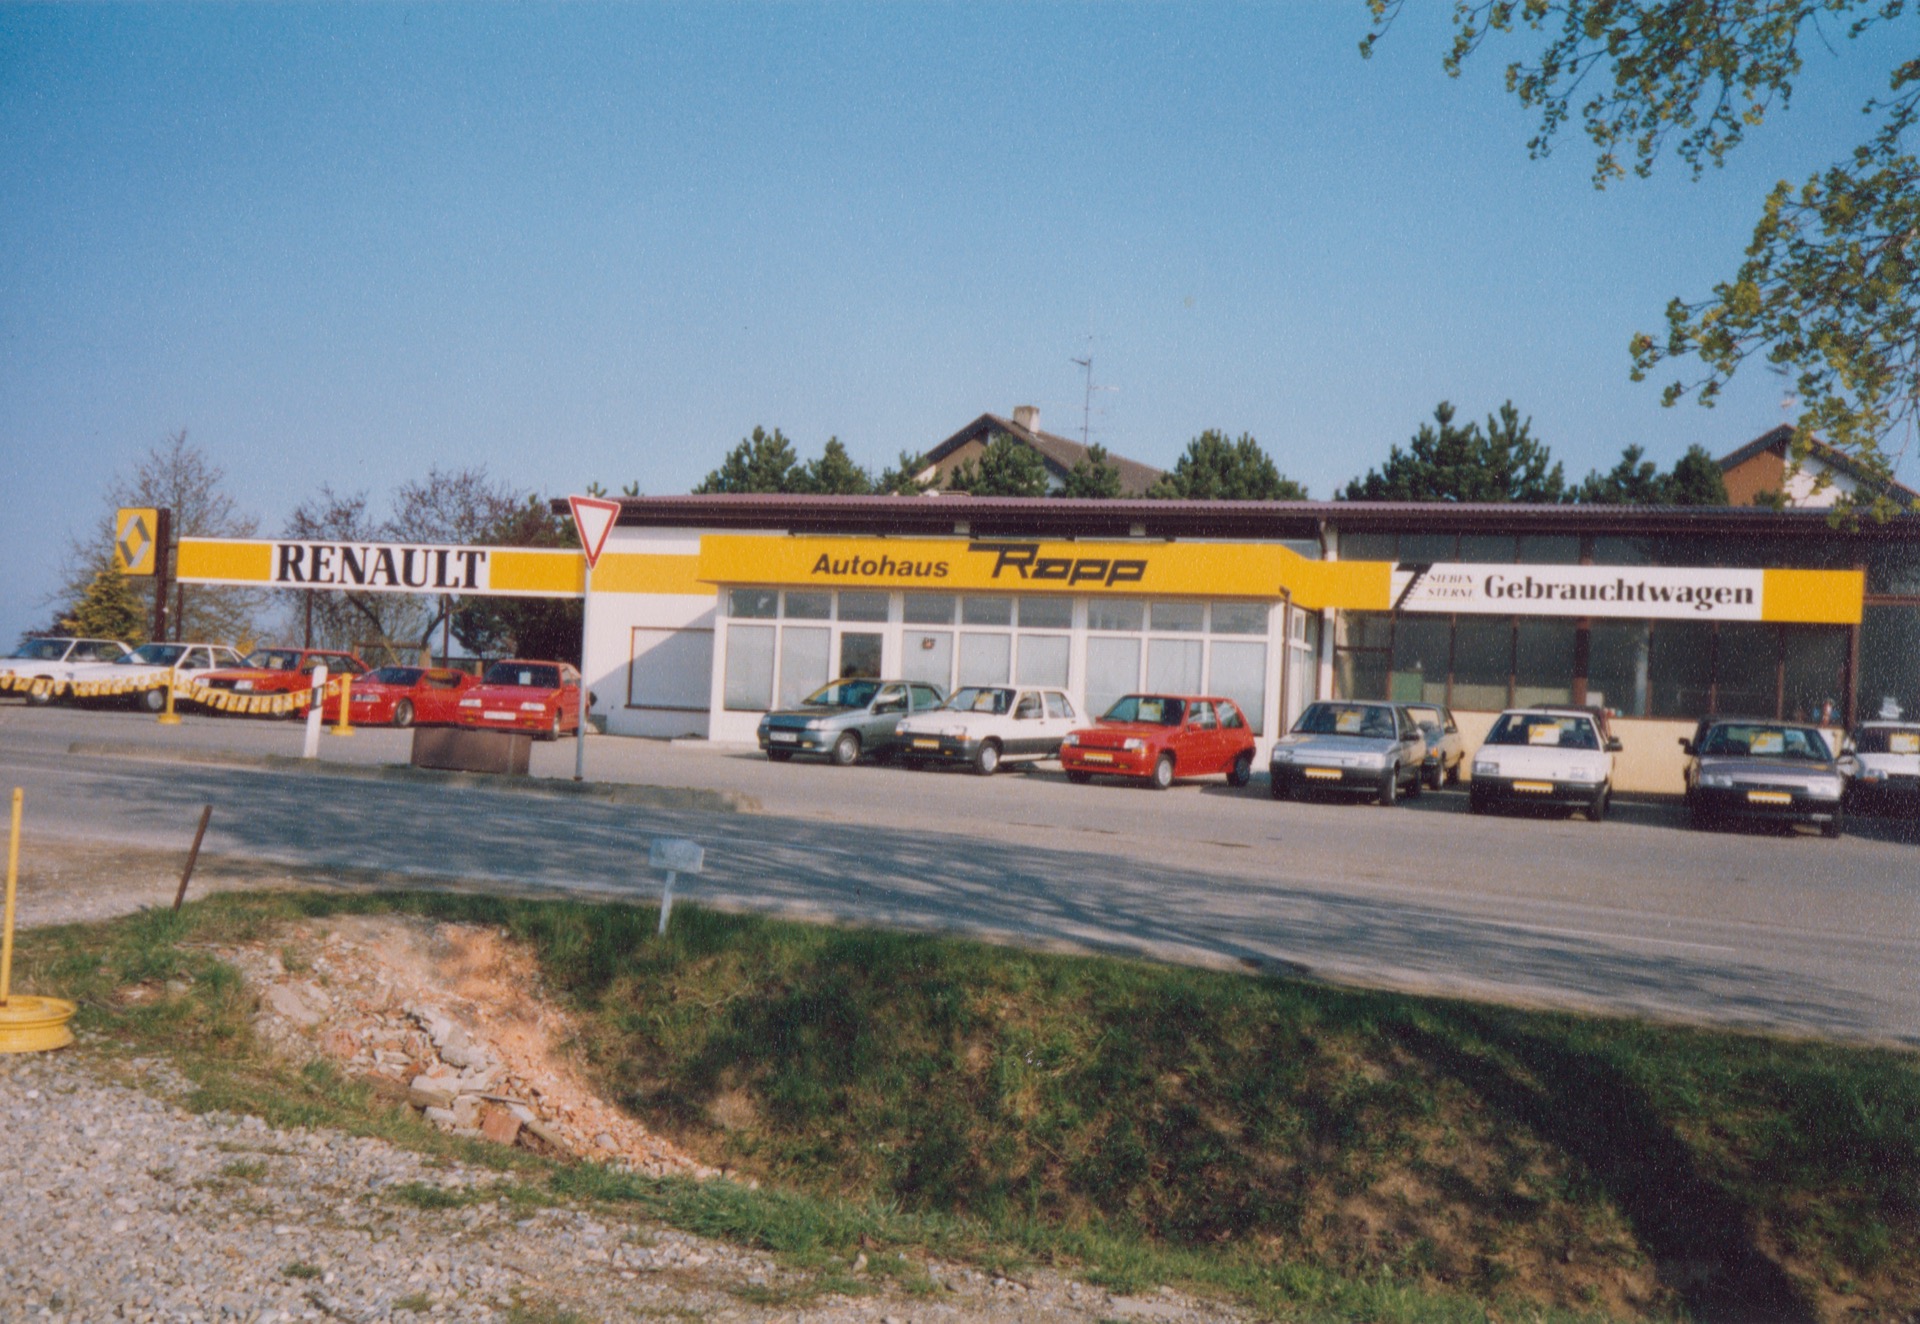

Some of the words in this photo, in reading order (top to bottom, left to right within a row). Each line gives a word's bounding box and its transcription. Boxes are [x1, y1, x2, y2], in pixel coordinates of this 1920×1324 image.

[277, 543, 487, 590] RENAULT
[811, 552, 949, 578] Autohaus
[1484, 574, 1754, 611] Gebrauchtwagen
